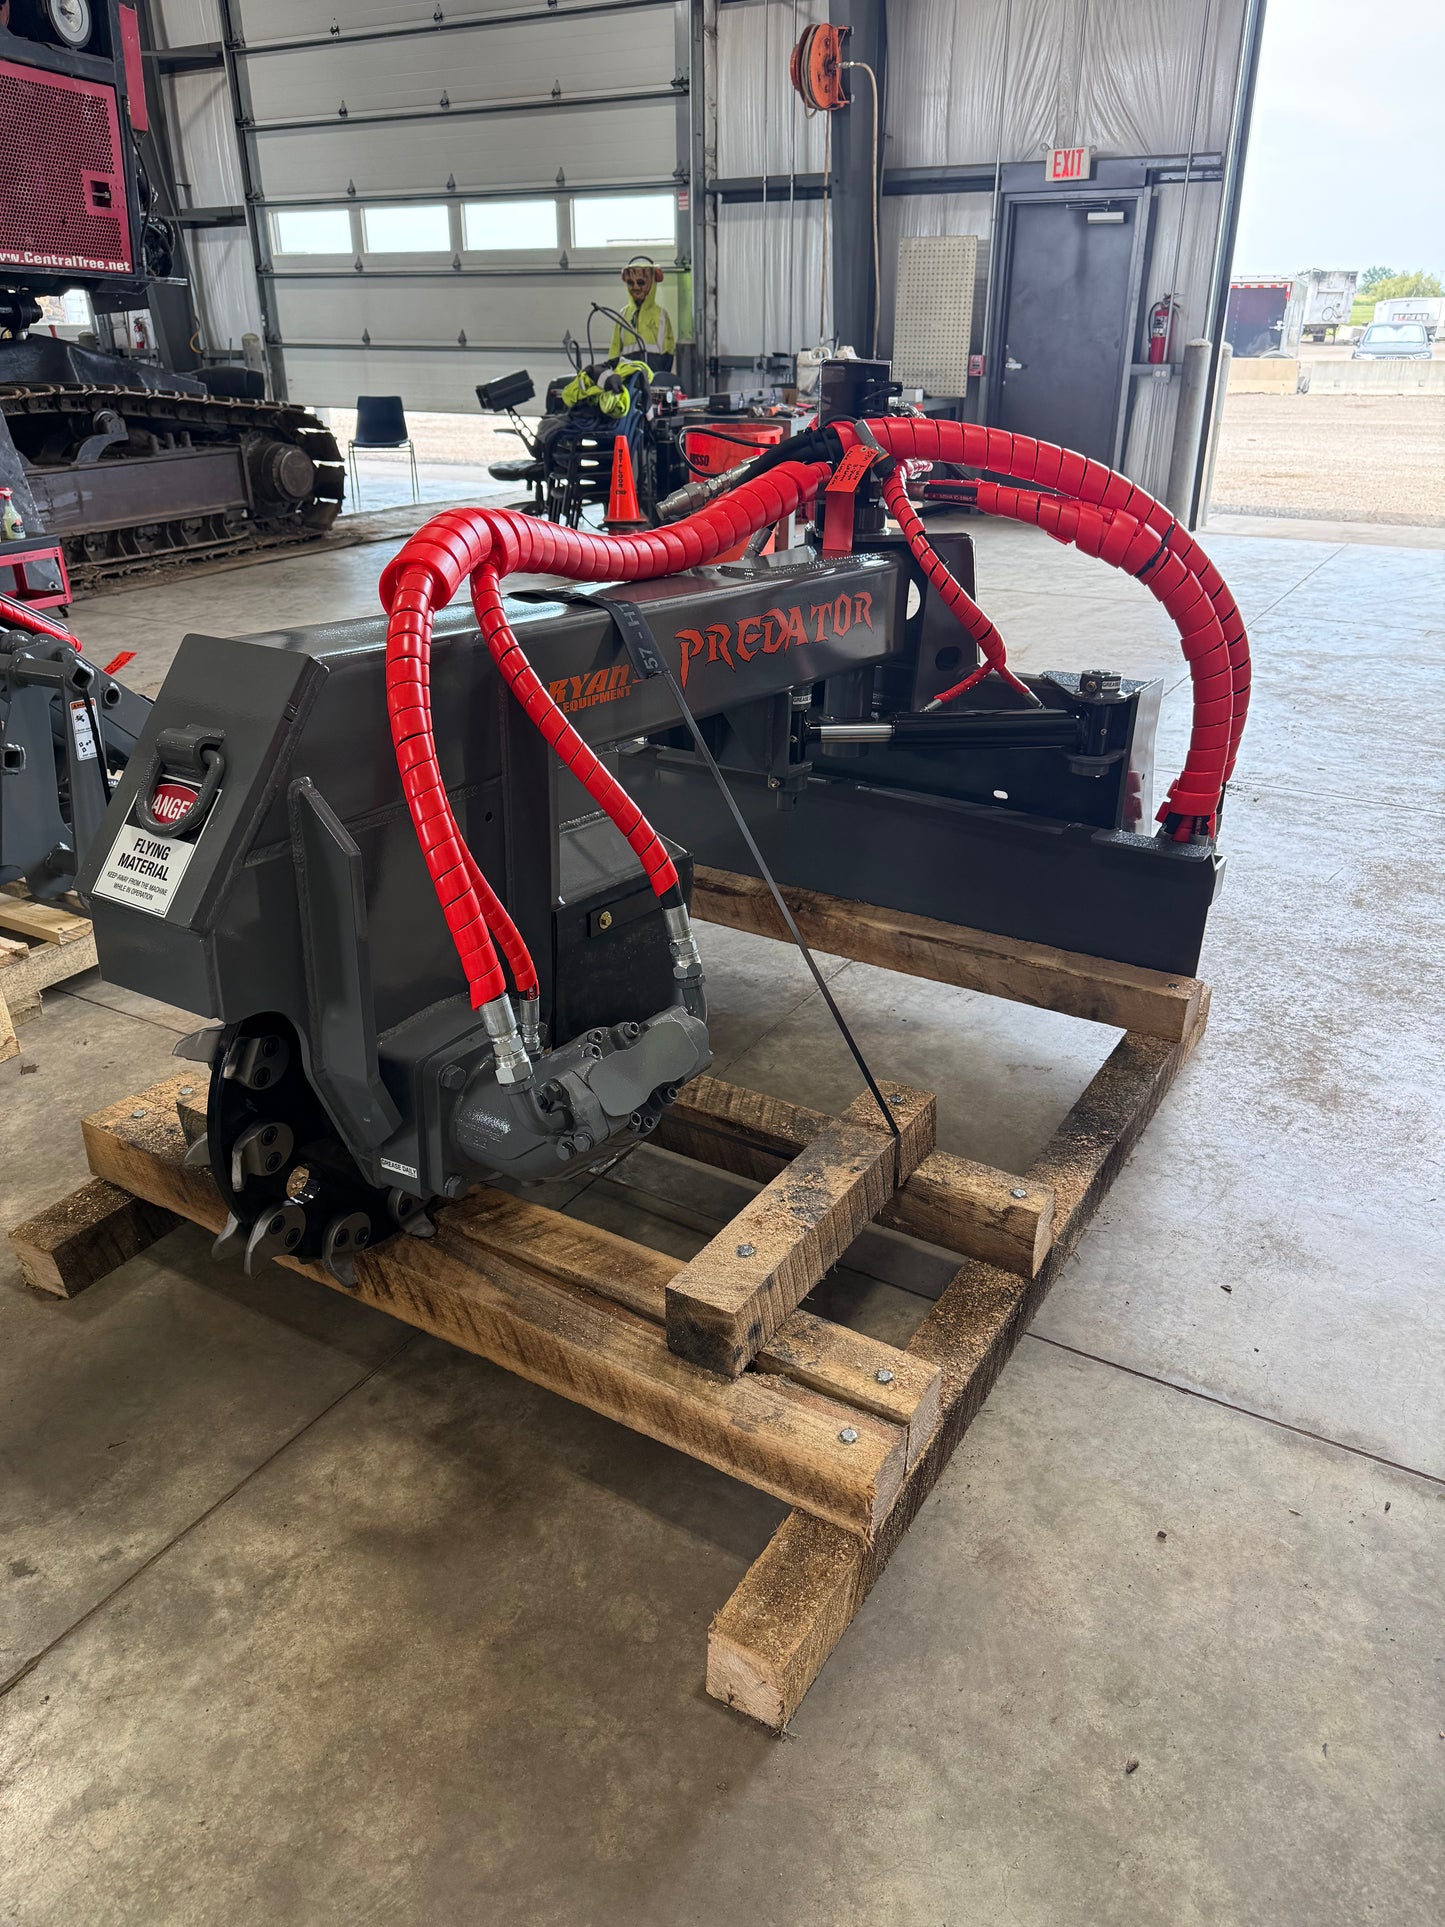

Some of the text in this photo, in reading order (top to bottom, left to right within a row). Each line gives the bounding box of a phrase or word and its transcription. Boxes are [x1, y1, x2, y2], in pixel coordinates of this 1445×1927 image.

[1053, 148, 1084, 178] EXIT
[674, 591, 873, 695] PREDATOR
[548, 664, 629, 704] RYAN
[562, 685, 632, 713] EQUIPMENT
[152, 793, 193, 820] ANGE
[133, 837, 171, 861] FLYING
[117, 852, 169, 881] MATERIAL
[107, 871, 168, 896] KEEP AWAY FROM THE MACHINE
[113, 882, 126, 891] WHILE
[131, 888, 154, 900] OPERATION
